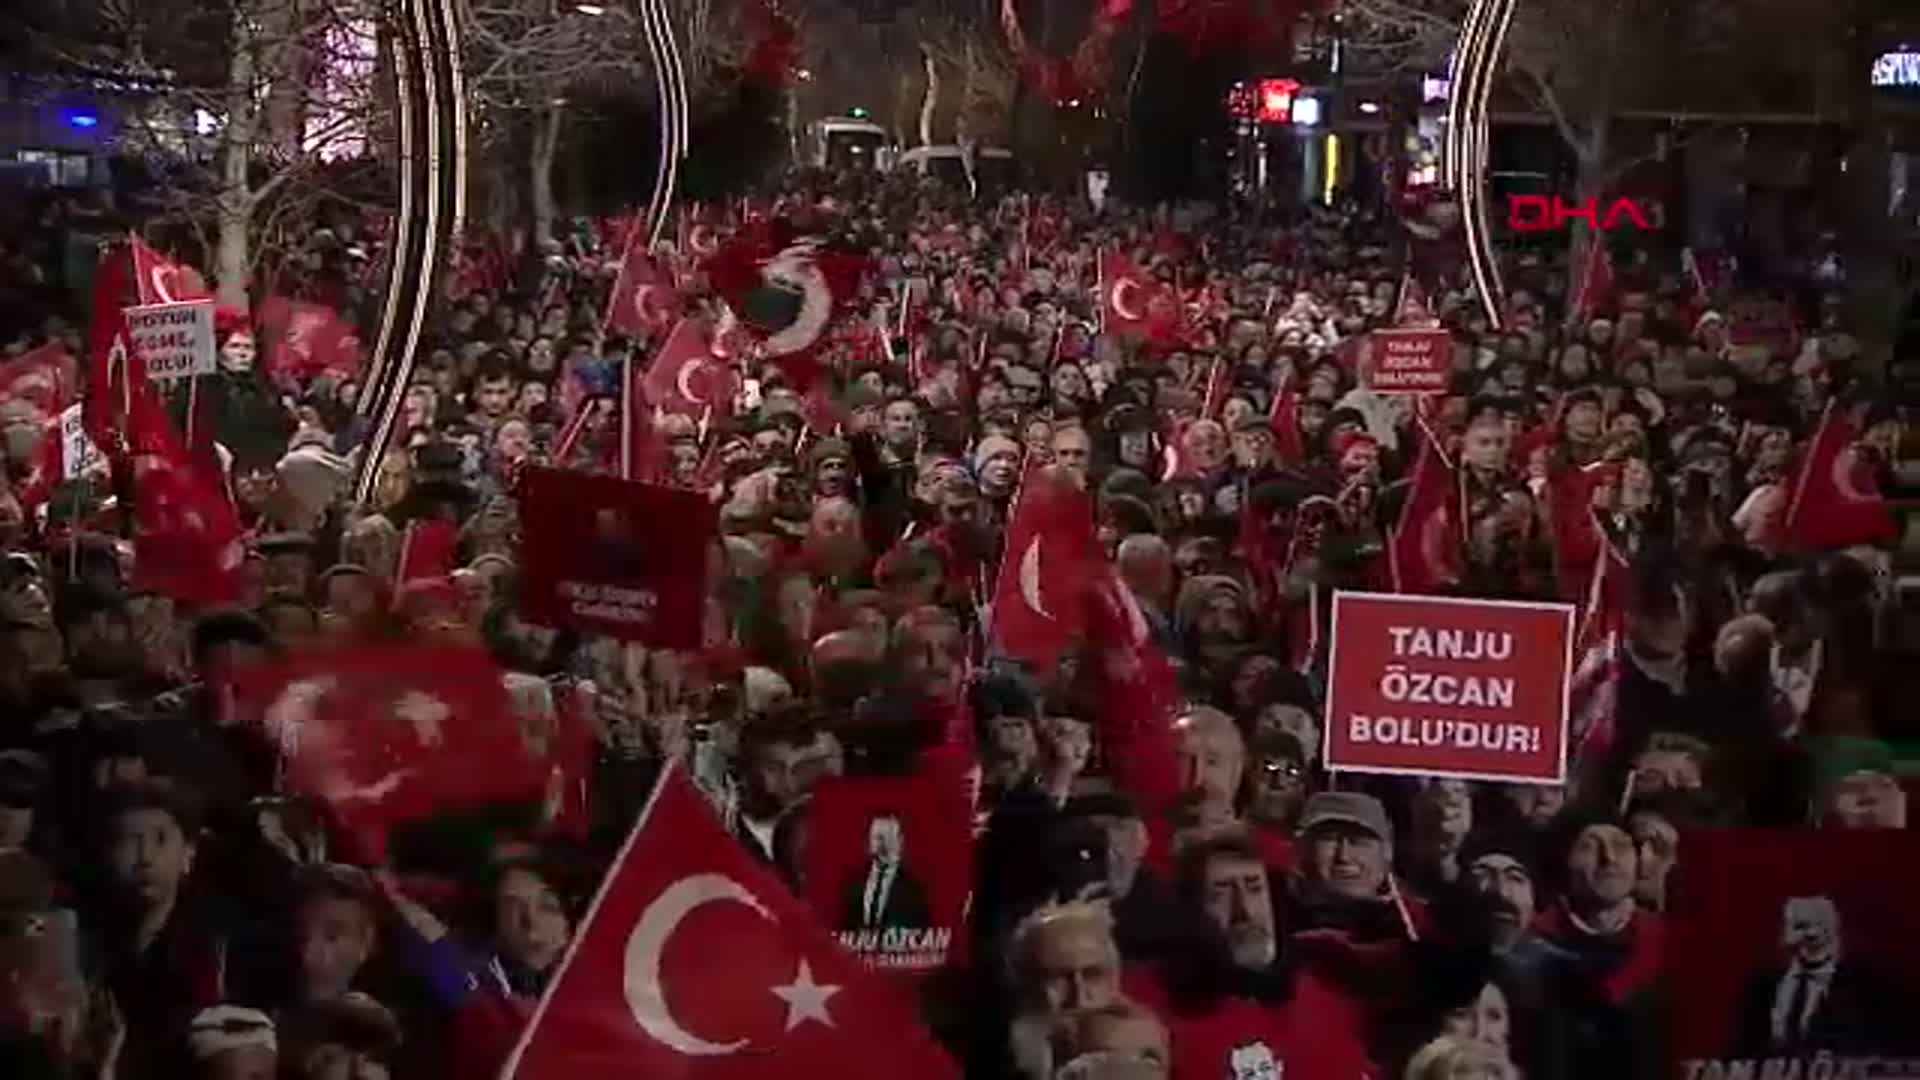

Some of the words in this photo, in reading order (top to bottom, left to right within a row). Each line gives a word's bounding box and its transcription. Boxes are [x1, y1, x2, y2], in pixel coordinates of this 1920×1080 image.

[148, 354, 194, 372] OLU!
[1388, 626, 1513, 660] TANJU
[1381, 664, 1515, 708] ÖZCAN
[1349, 713, 1541, 753] BOLU'DUR!
[881, 926, 952, 951] ÖZCAN
